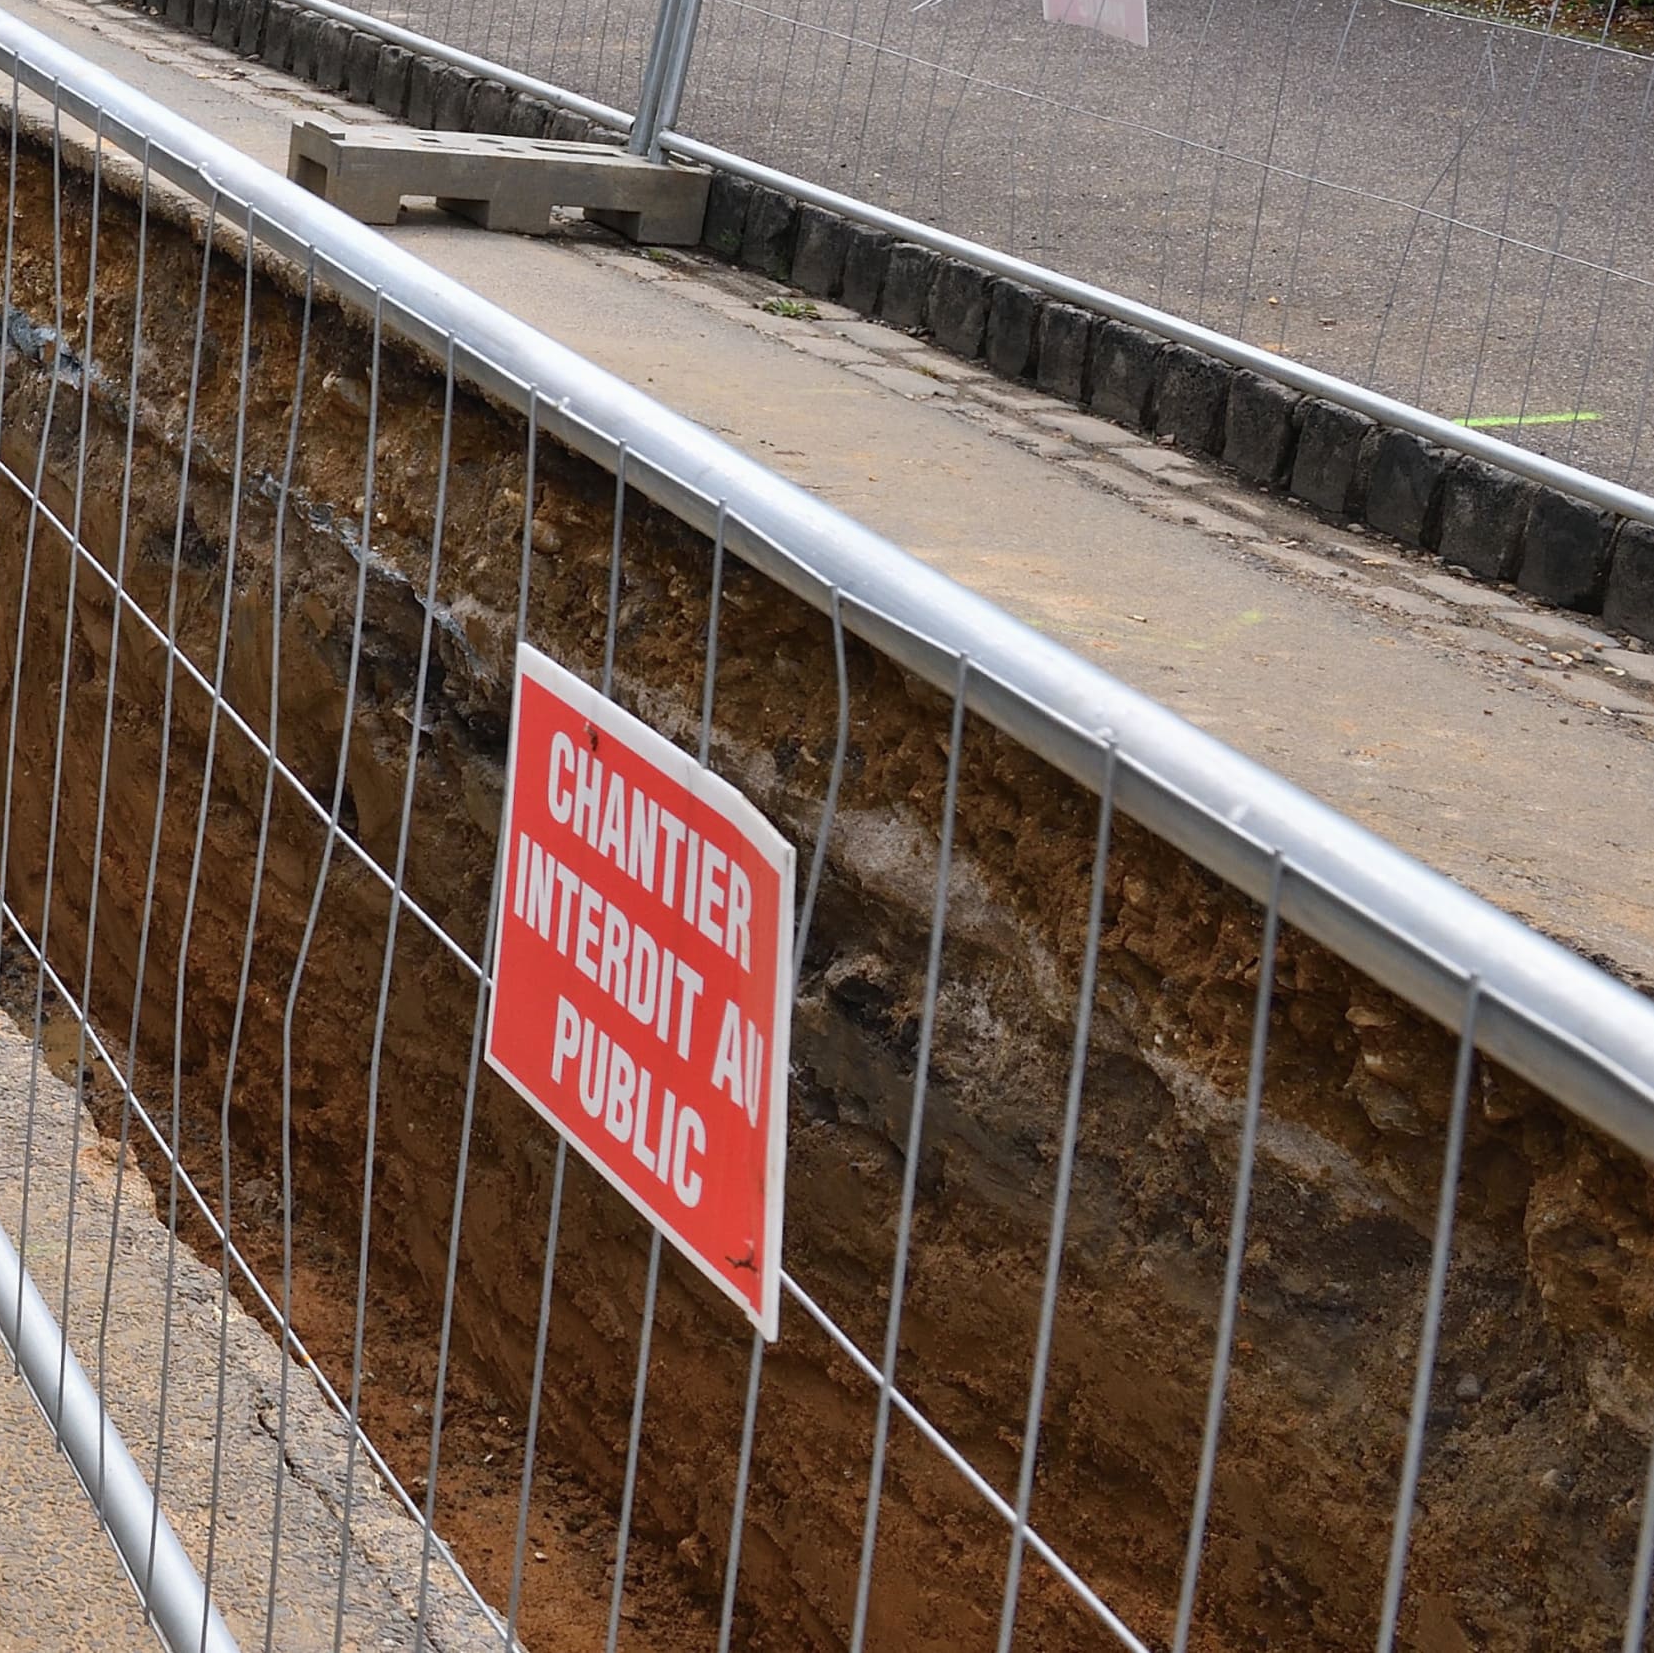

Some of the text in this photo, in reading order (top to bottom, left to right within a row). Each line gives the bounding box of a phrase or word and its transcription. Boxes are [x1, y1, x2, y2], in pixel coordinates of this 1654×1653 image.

[547, 730, 753, 974] CHANTIER
[513, 831, 764, 1129] INTERDIT AU
[551, 993, 707, 1209] PUBLIC
